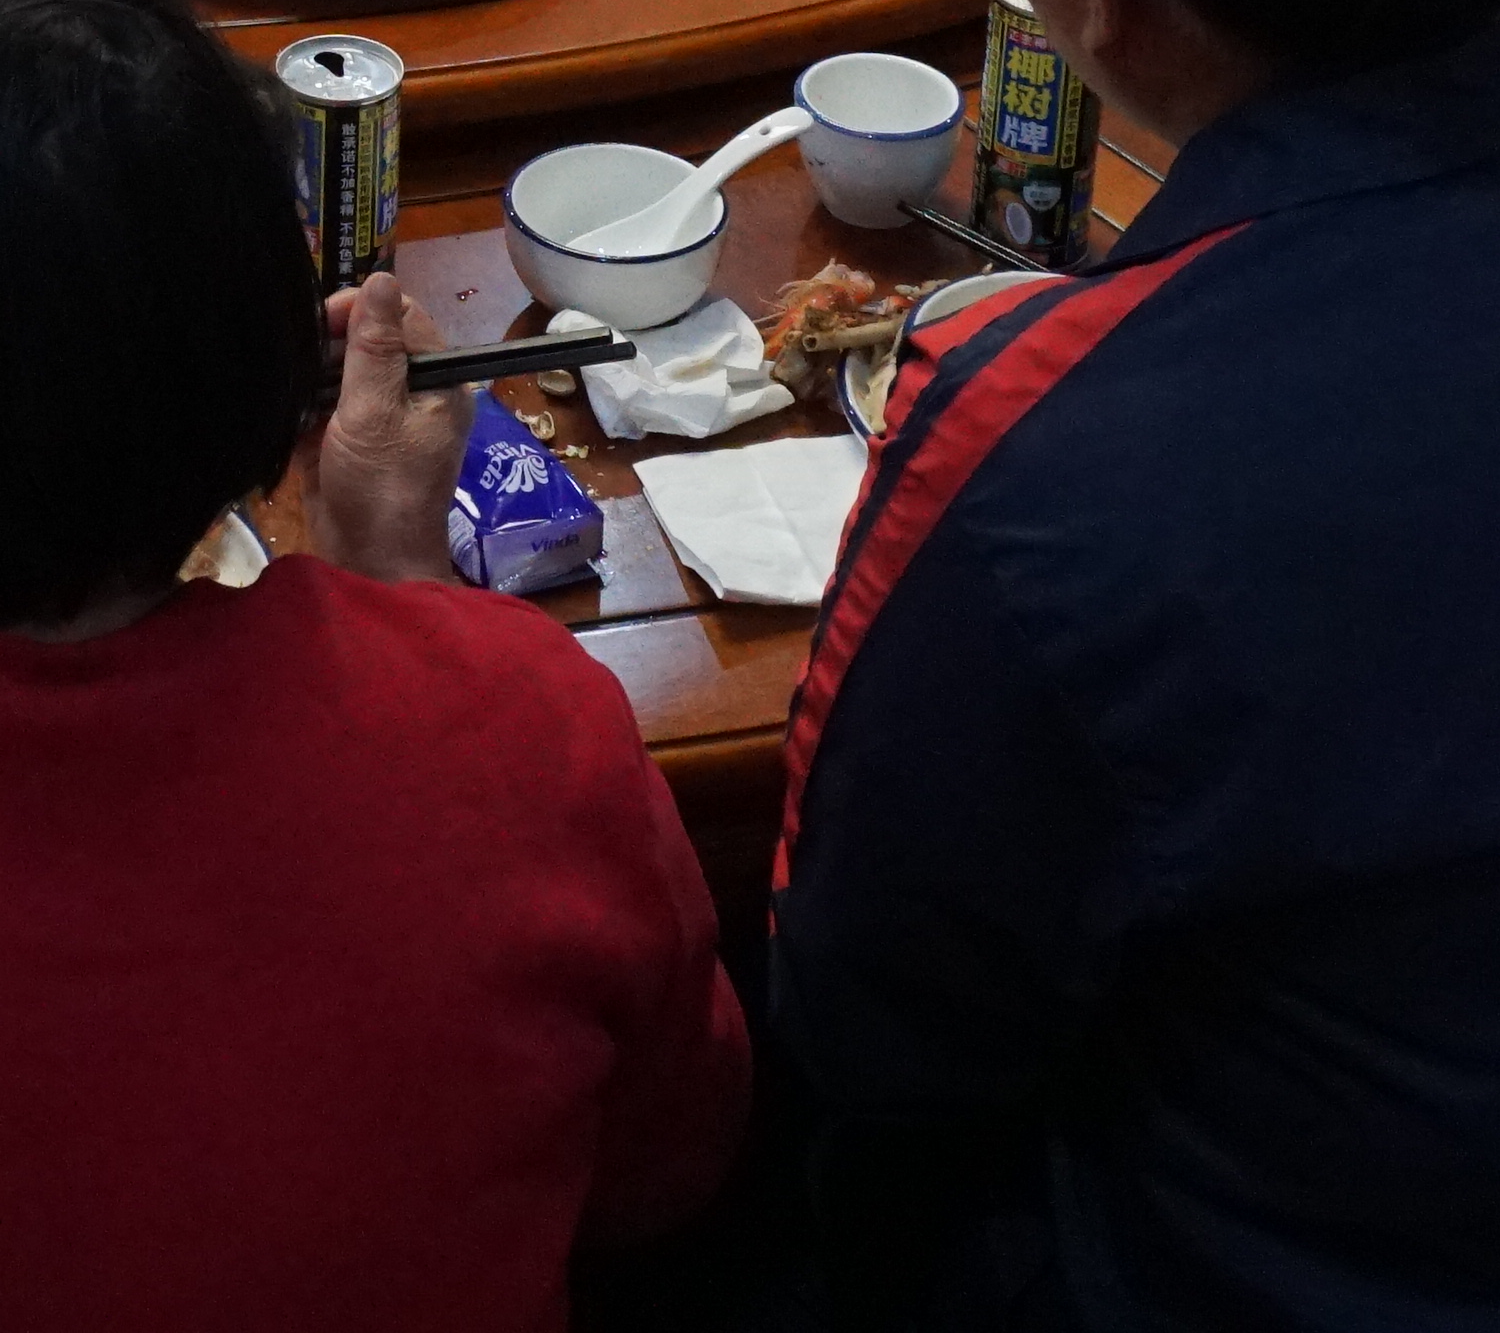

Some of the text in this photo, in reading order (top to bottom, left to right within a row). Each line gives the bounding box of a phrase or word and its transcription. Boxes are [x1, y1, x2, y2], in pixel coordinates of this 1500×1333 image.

[1000, 44, 1056, 154] 椰树牌
[479, 443, 541, 490] Vinda
